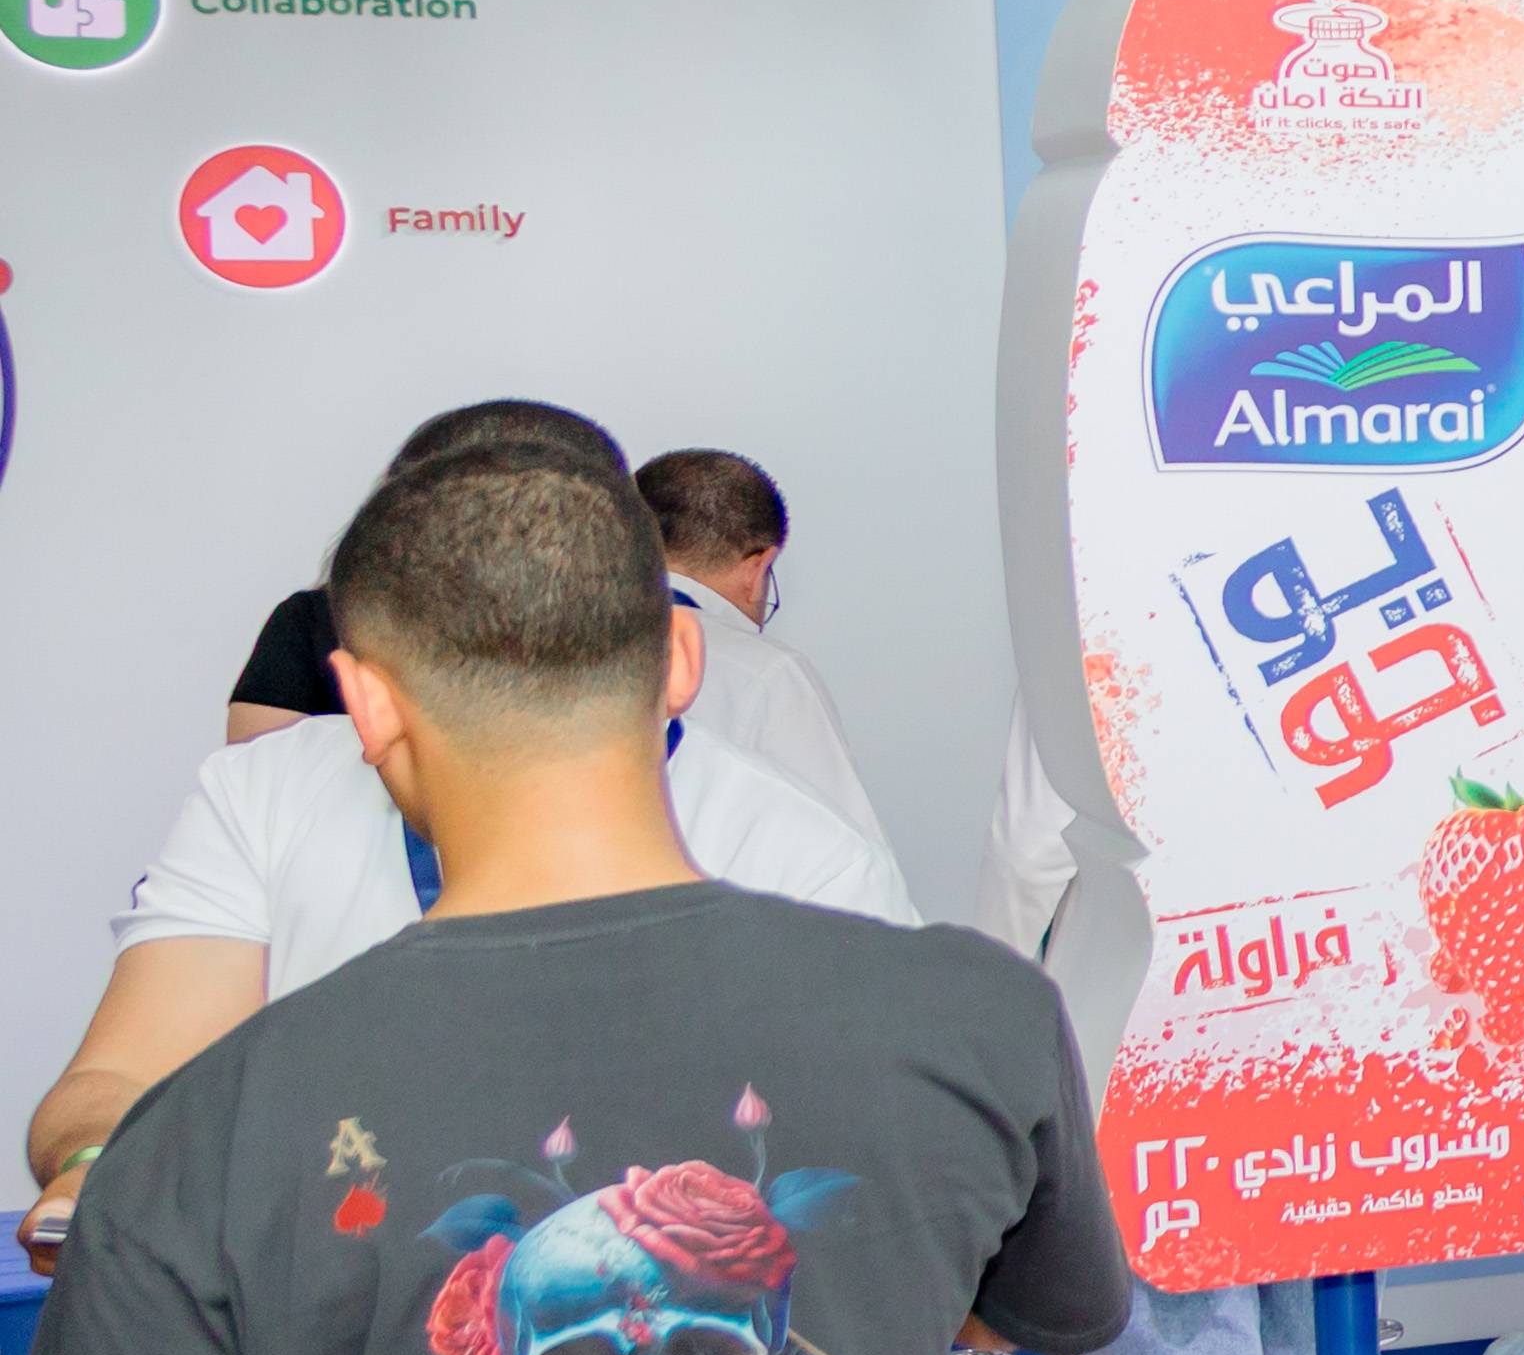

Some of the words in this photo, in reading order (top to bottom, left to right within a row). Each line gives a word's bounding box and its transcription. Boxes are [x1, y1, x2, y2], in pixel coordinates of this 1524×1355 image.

[1303, 58, 1377, 83] صوت
[1260, 116, 1273, 128] if
[1278, 116, 1290, 128] it
[1296, 117, 1348, 131] clicks,
[1383, 118, 1422, 130] safe
[387, 204, 527, 239] Family
[1211, 260, 1483, 337] المراعي
[1213, 389, 1485, 447] Almarai
[1174, 908, 1352, 998] فراولة
[1234, 1133, 1337, 1199] زبادي
[1352, 1112, 1511, 1171] مشروب
